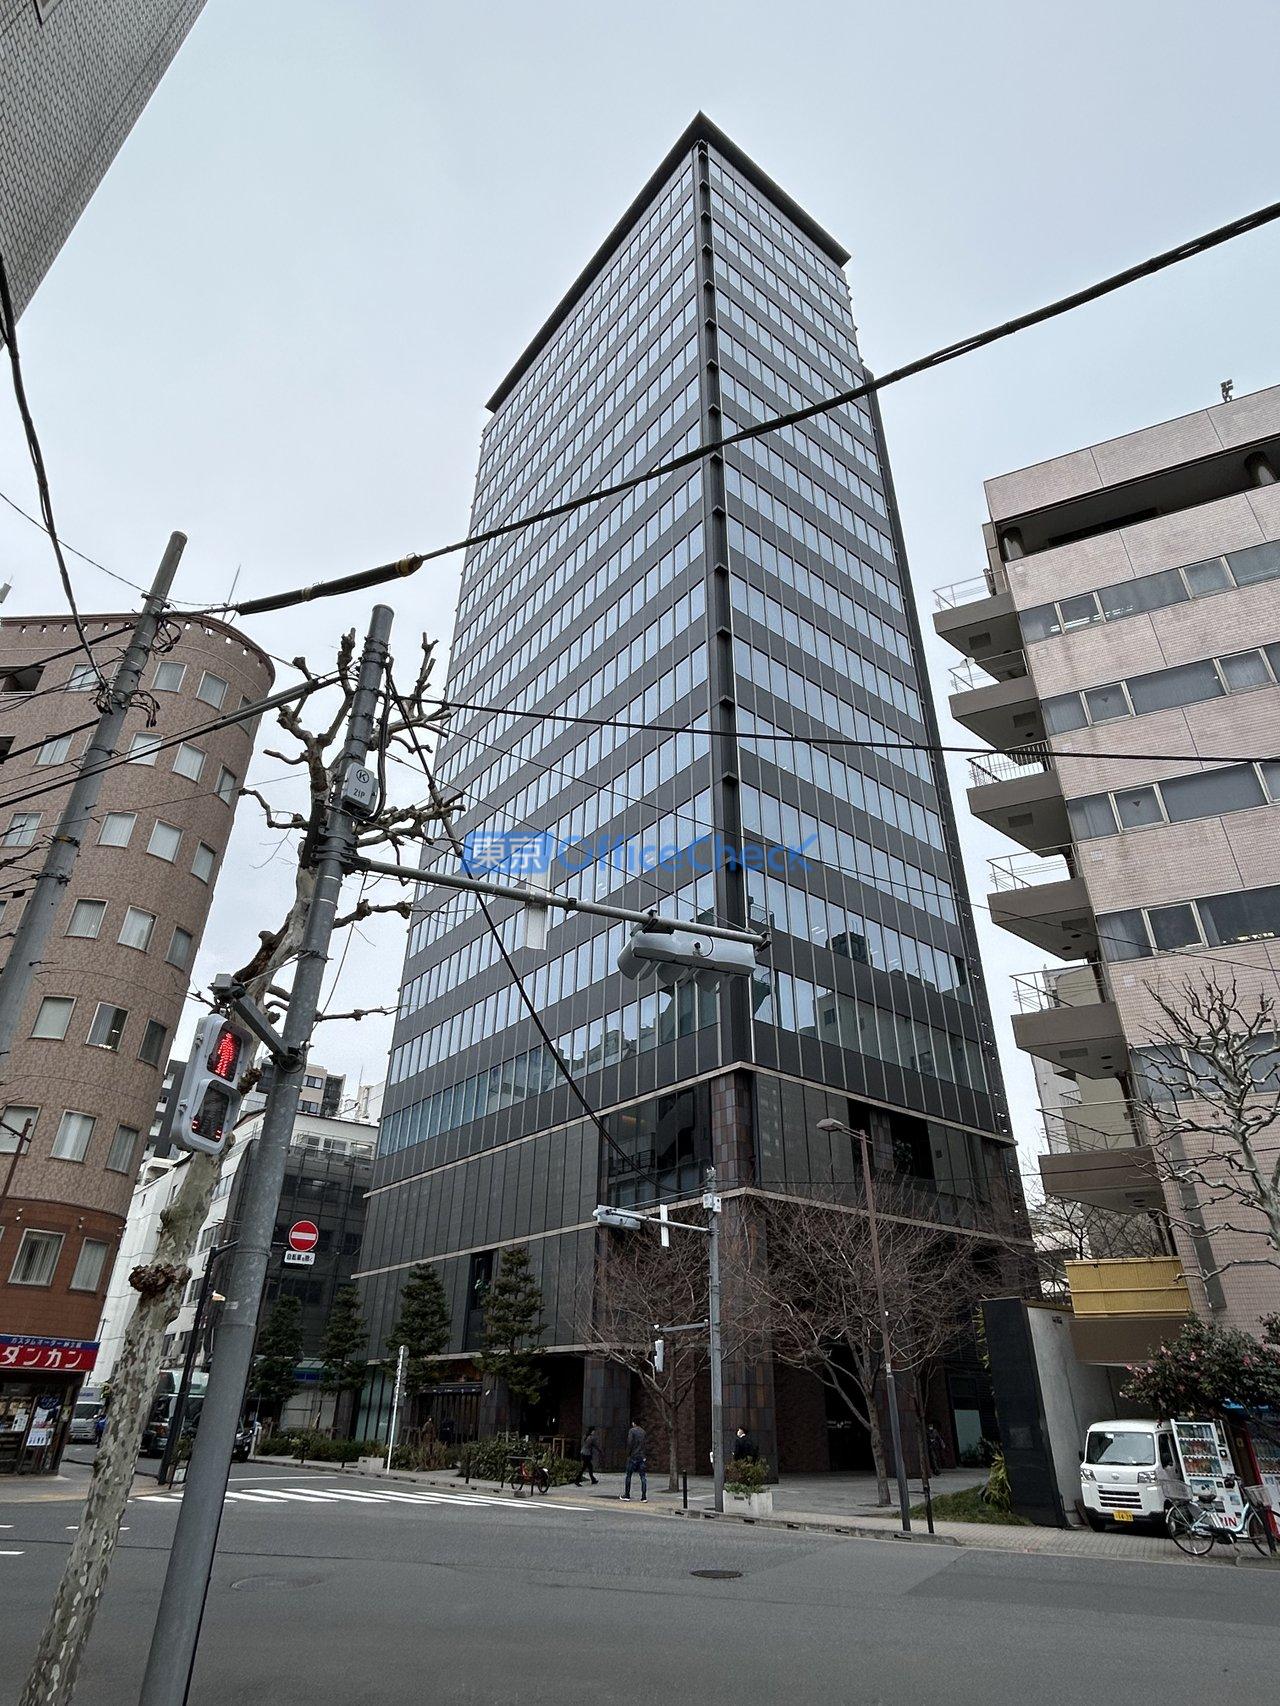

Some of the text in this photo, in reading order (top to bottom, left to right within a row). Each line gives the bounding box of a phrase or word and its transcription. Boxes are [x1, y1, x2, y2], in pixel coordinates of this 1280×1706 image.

[353, 788, 366, 798] ZIP
[0, 1345, 82, 1368] ダンカン
